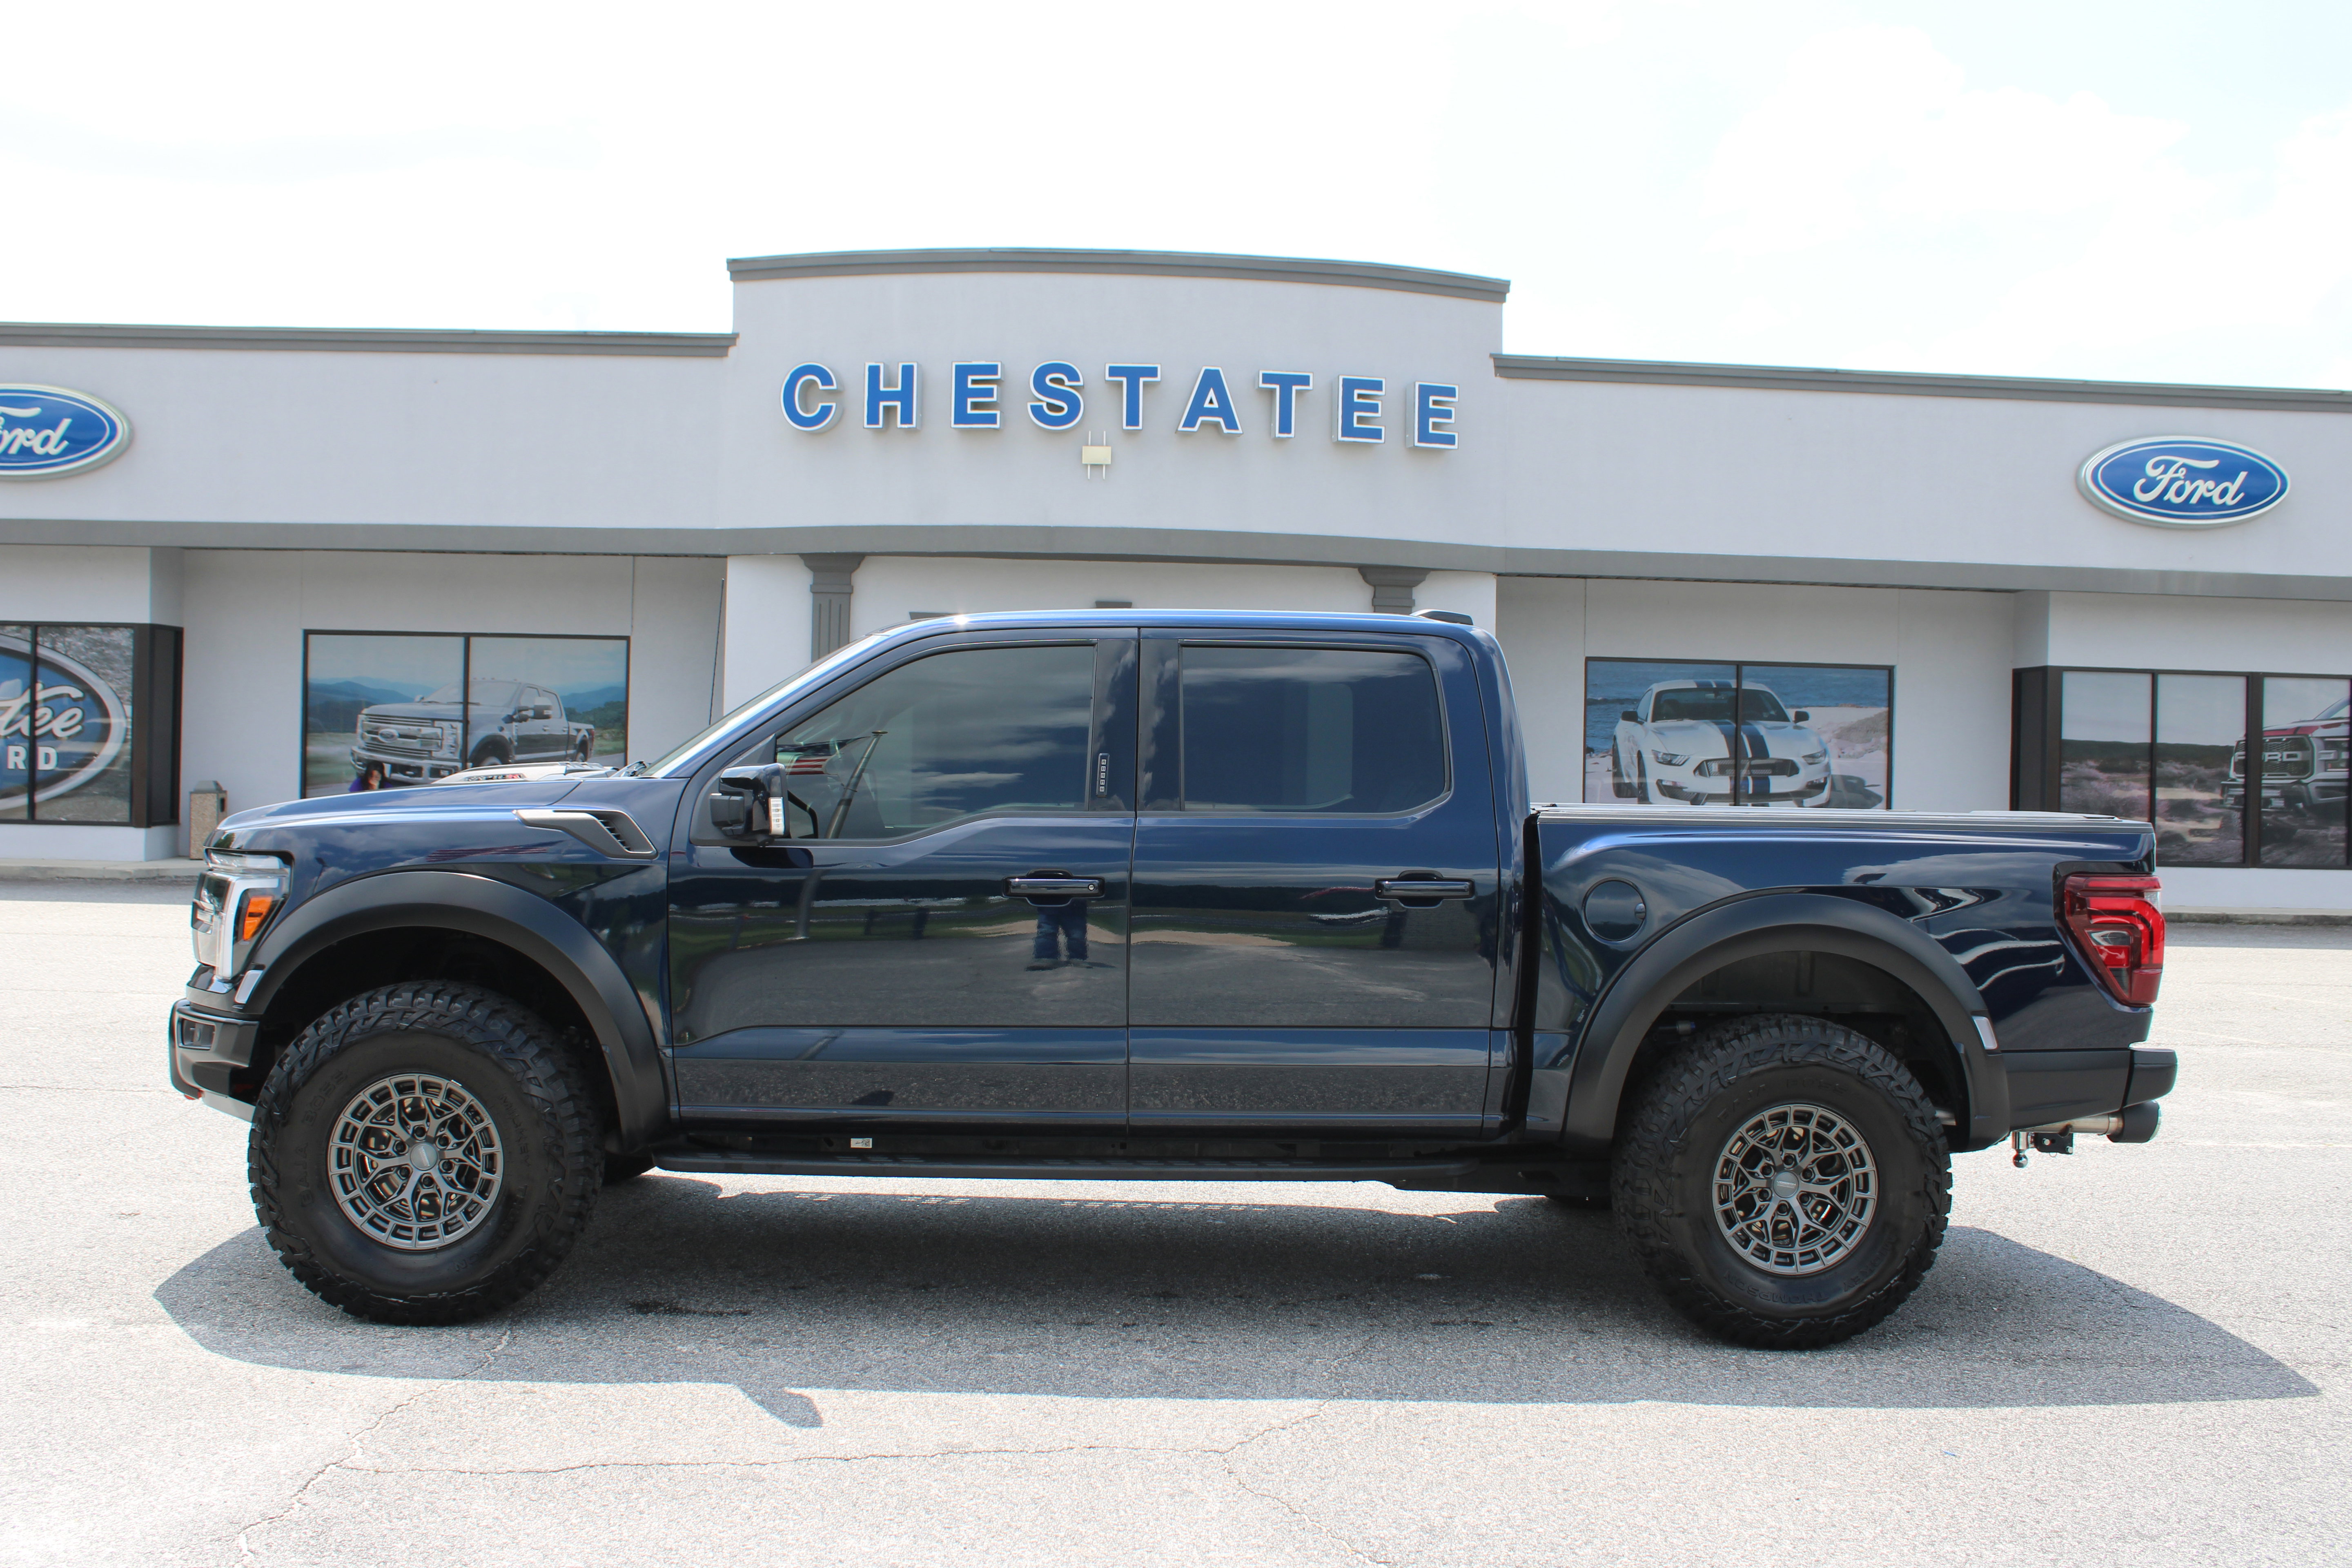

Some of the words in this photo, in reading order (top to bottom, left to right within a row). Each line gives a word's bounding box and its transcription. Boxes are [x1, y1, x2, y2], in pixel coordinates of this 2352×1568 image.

[780, 361, 1459, 450] CHESTATEE
[2134, 455, 2248, 506] Ford
[2234, 751, 2303, 762] FRD
